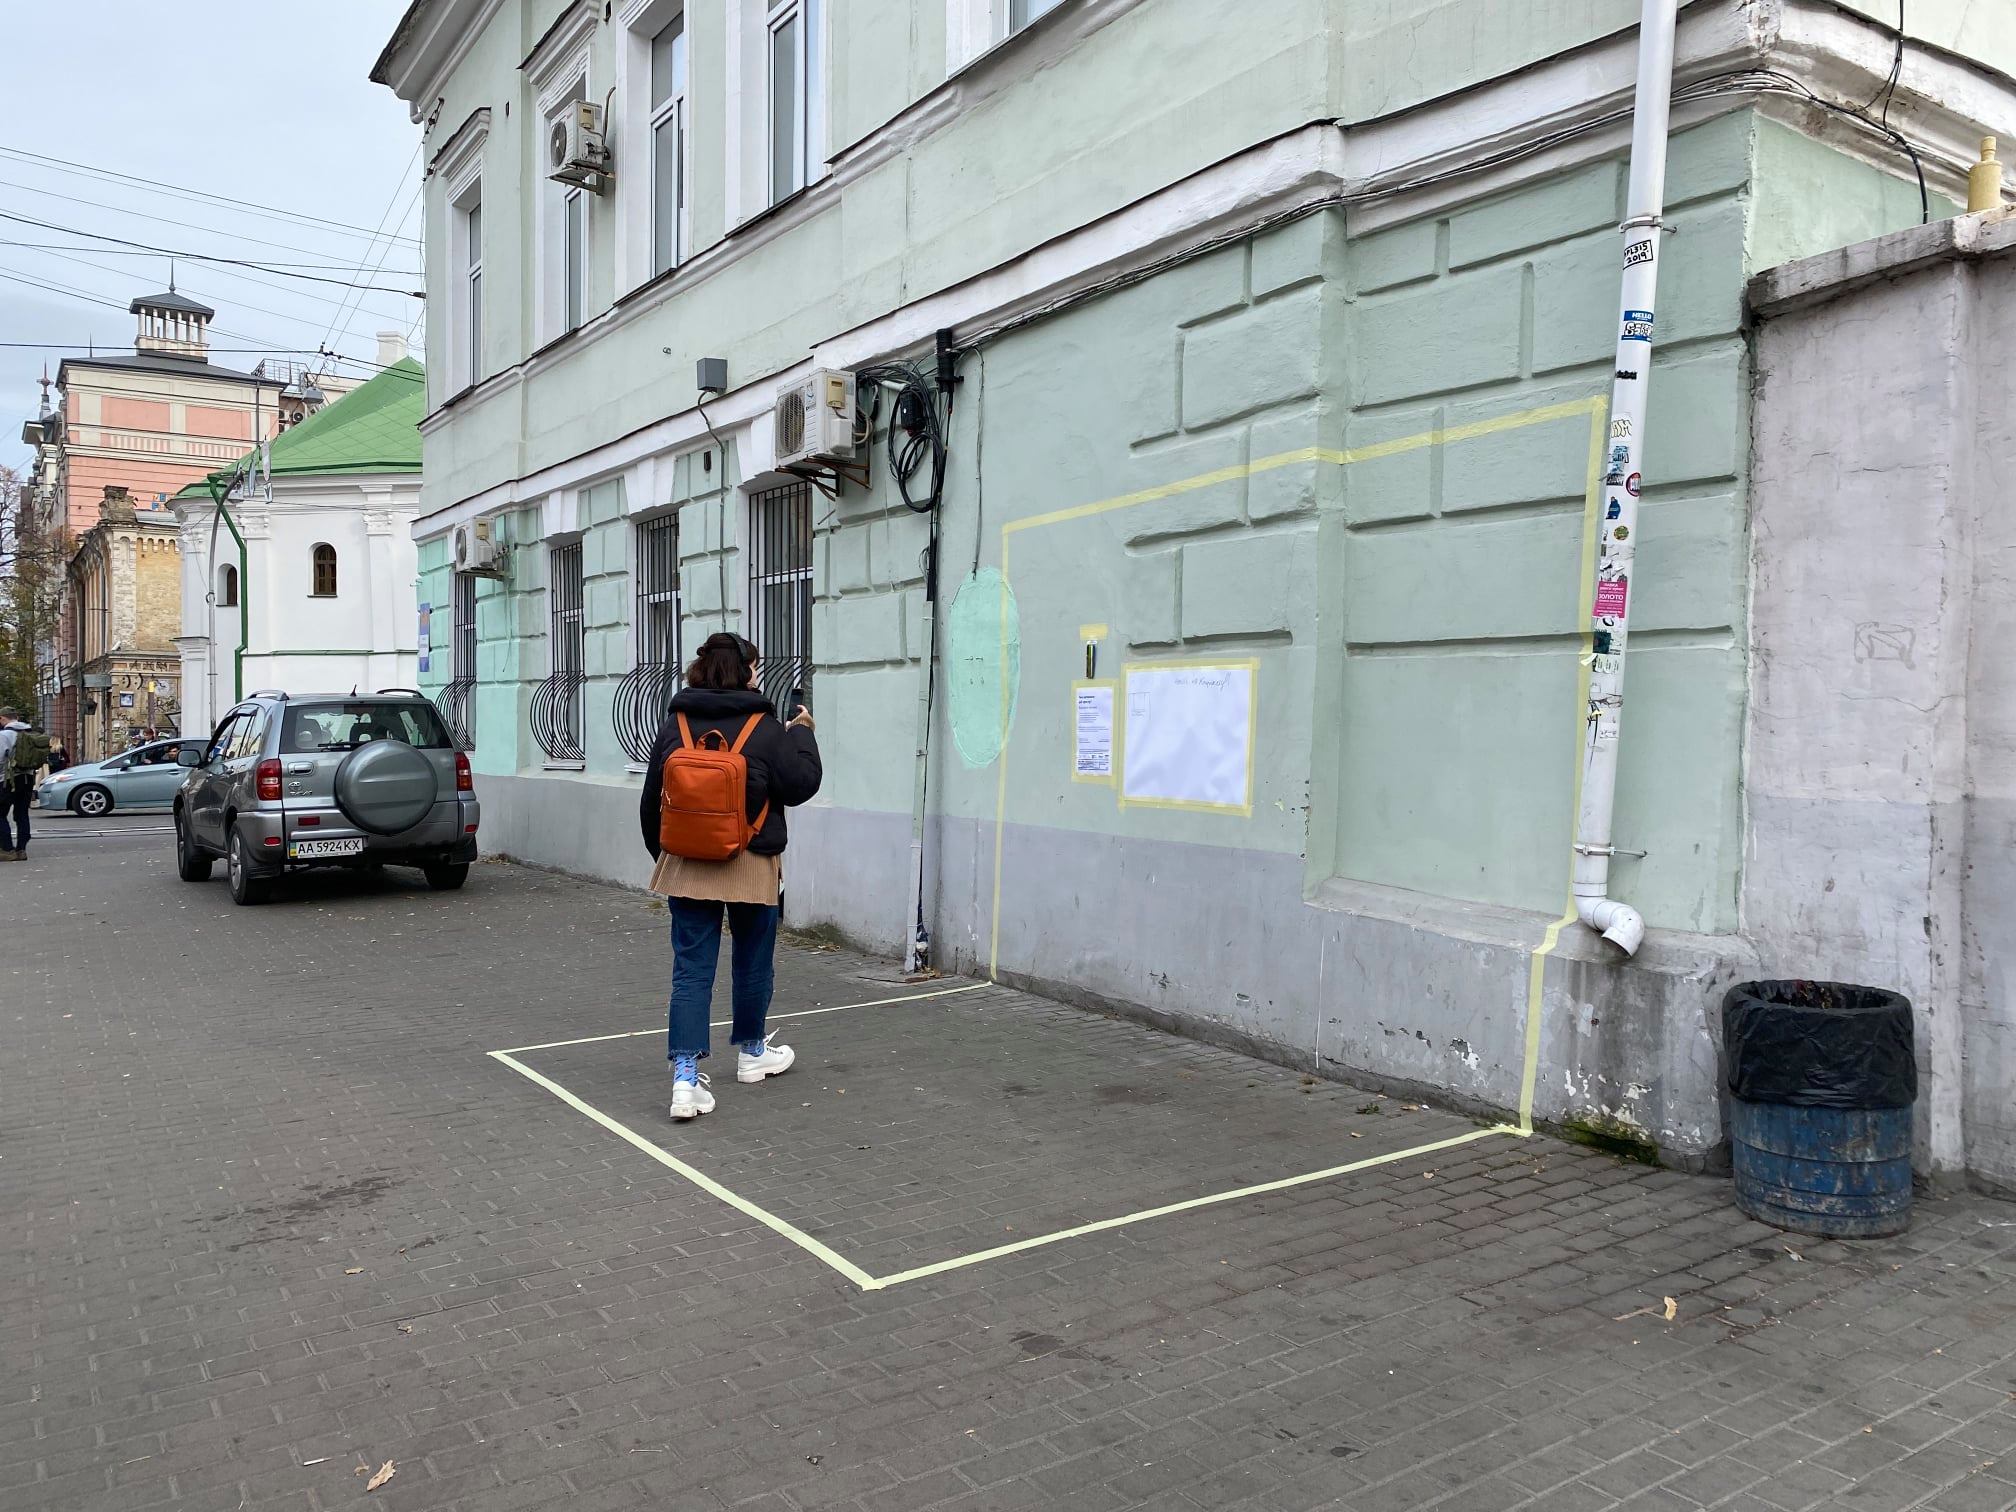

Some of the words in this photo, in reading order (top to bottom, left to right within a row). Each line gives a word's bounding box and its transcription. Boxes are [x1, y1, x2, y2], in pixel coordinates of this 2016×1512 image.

[298, 843, 314, 854] AA
[316, 841, 342, 853] 5924
[343, 839, 360, 851] KX
